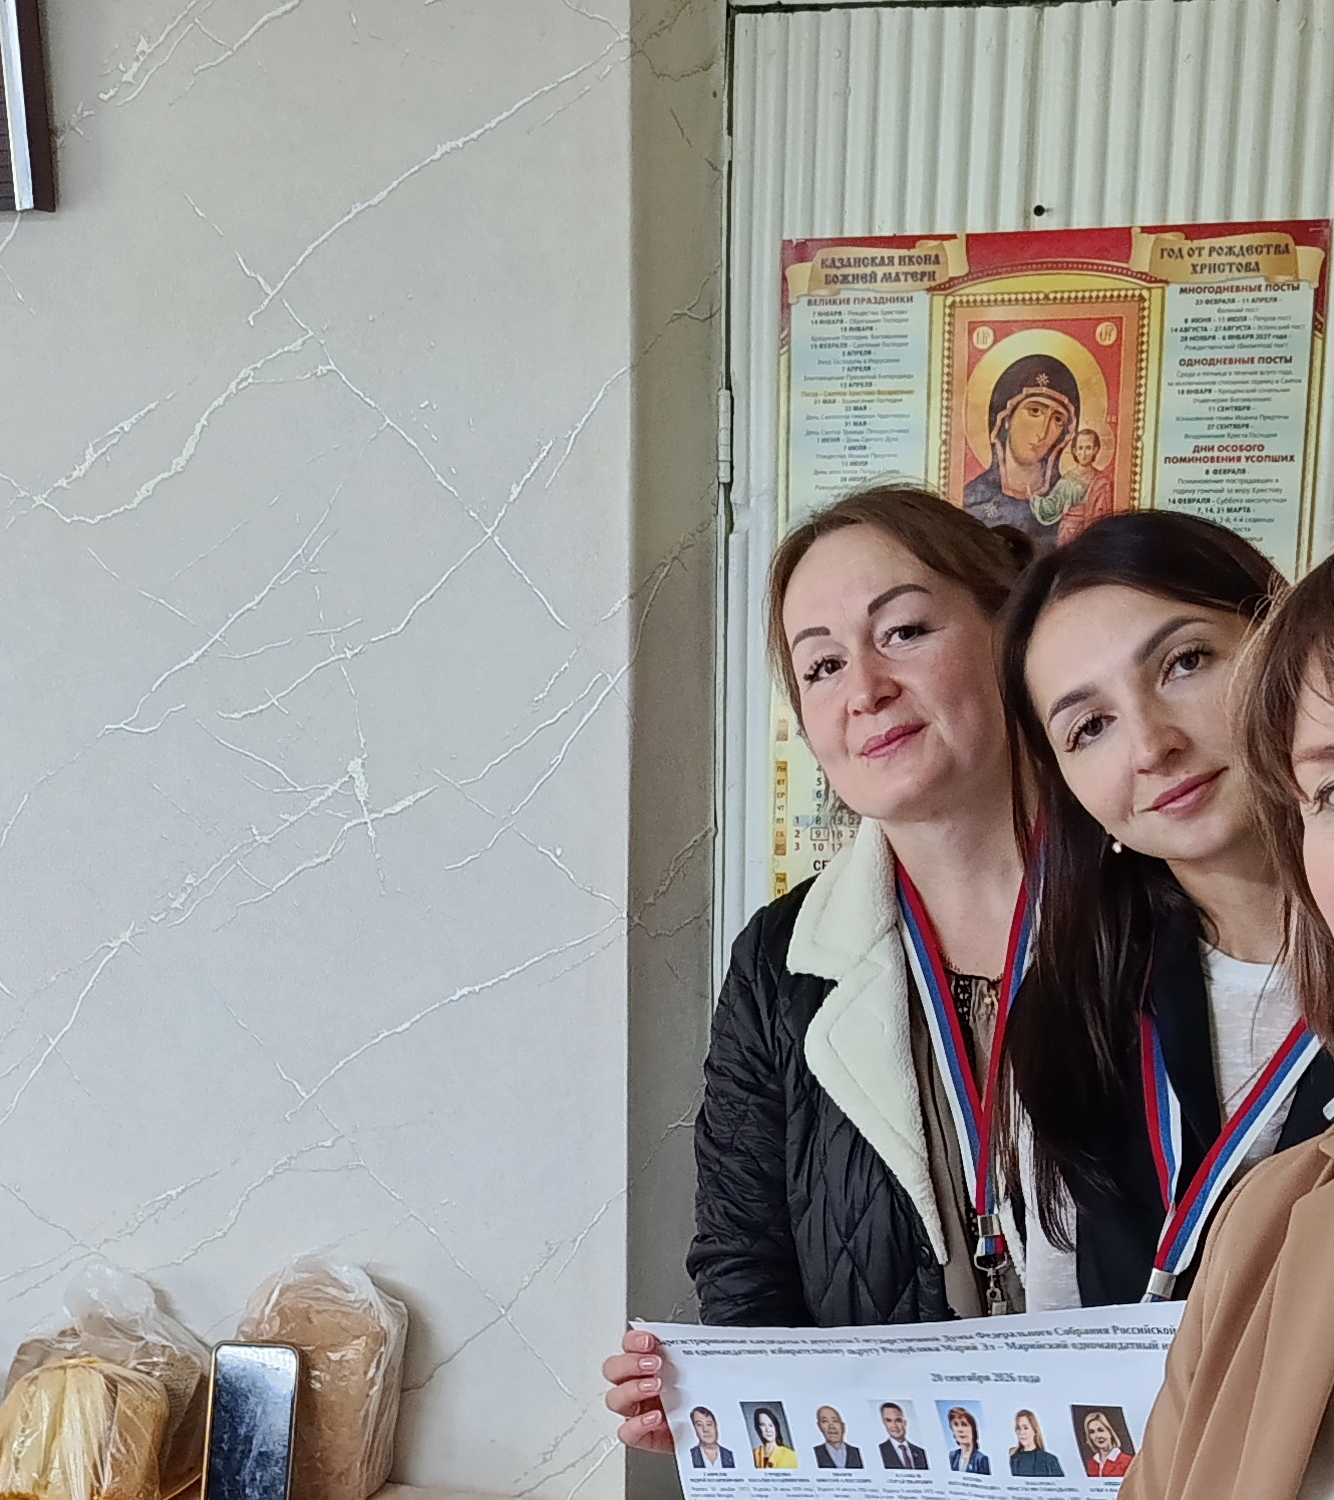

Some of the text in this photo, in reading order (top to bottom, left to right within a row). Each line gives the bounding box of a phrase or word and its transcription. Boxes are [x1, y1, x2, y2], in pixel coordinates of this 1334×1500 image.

[1159, 243, 1291, 260] ГОД ОТ РОЖДЕСТВА
[820, 253, 941, 270] КАЗАНСКАЯ ИКОНА
[1190, 261, 1261, 275] ХРИСТОВА
[880, 270, 937, 283] МАТЕРИ
[1179, 283, 1300, 295] МНОГОДНЕВНЫЕ ПОСТЫ
[806, 296, 914, 307] ВЕЛИКИЕ ПРАЗДНИКИ
[1178, 356, 1293, 368] ОДНОДНЕВНЫЕ ПОСТЫ
[1192, 444, 1265, 455] ДНИ ОСОБОГО
[1164, 454, 1296, 465] ПОМИНОВЕНИЯ УСОПШИХ
[816, 778, 822, 786] 5
[816, 790, 822, 799] 6
[794, 830, 800, 838] 2
[815, 830, 821, 838] 9
[794, 843, 800, 851] 3
[813, 843, 824, 851] 10
[1054, 1326, 1109, 1337] Собрания
[1111, 1324, 1177, 1335] Российской
